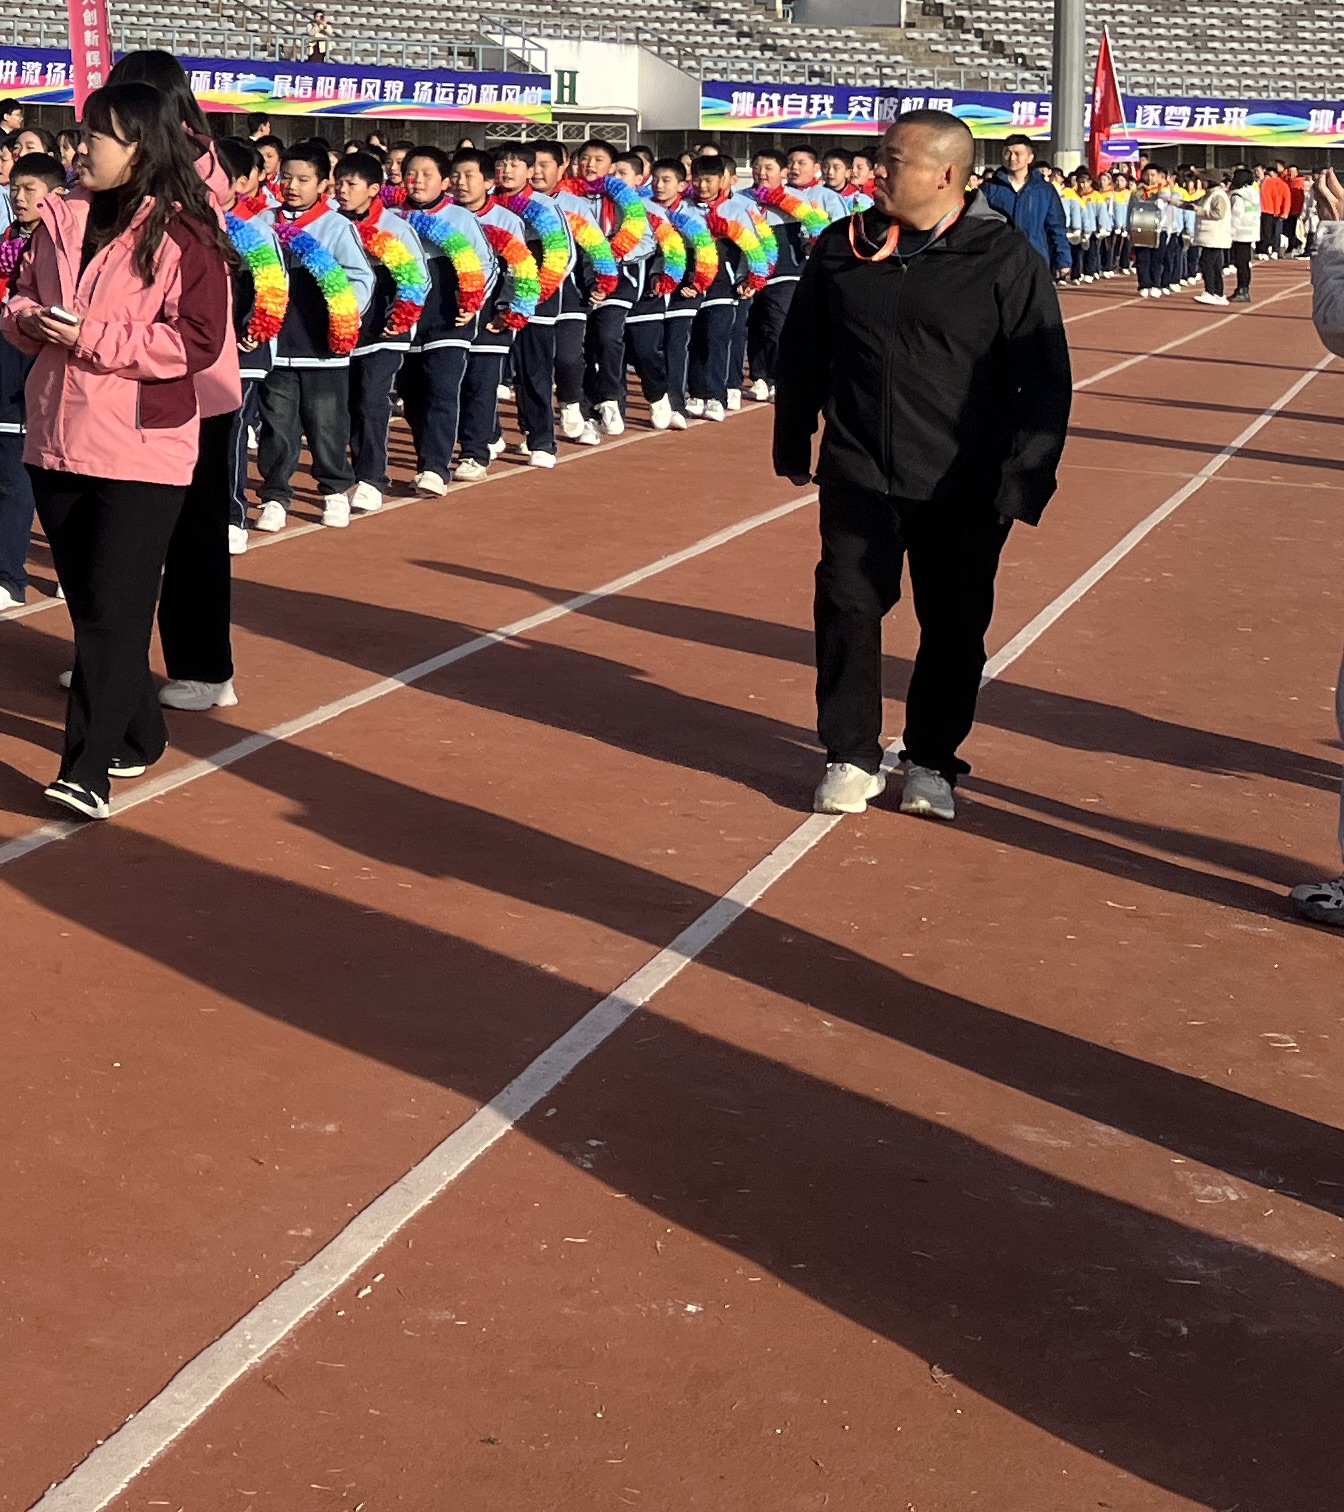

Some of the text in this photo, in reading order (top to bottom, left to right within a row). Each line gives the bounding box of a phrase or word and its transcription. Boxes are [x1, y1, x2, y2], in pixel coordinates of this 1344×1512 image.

[272, 74, 405, 103] 展信阳新风貌
[413, 80, 543, 107] 扬运动新风尚
[554, 69, 580, 106] H
[730, 90, 835, 119] 挑战自我
[1135, 104, 1249, 131] 逐梦未来
